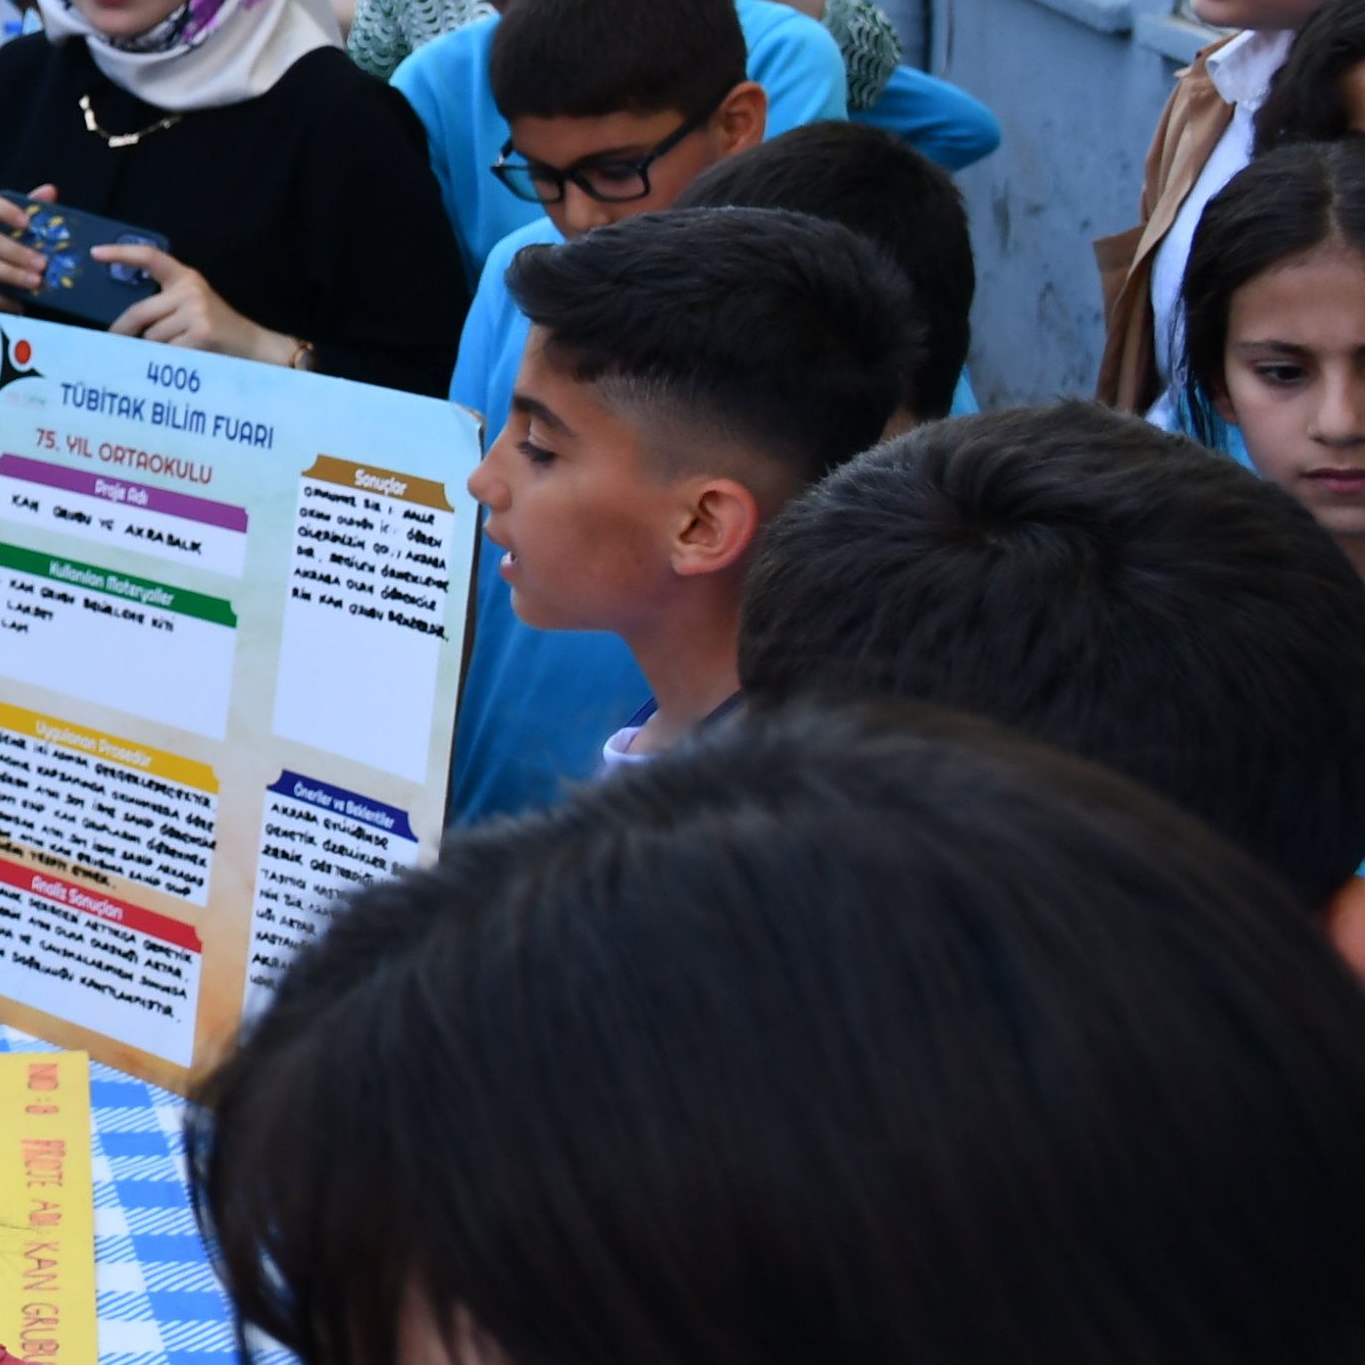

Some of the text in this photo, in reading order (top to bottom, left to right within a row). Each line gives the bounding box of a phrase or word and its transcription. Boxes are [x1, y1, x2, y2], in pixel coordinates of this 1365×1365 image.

[146, 361, 201, 394] 4006
[60, 381, 146, 423] TÜBİTAK
[150, 400, 207, 435] BİLİM
[212, 414, 274, 450] FUARI
[36, 427, 213, 485] 75. YIL ORTAOKULU
[92, 478, 125, 505] Proje
[352, 468, 408, 500] Sonuçlar
[124, 524, 202, 554] AKRABALIK
[333, 799, 345, 812] ve
[31, 875, 68, 901] Analiz
[23, 1241, 61, 1292] KAN
